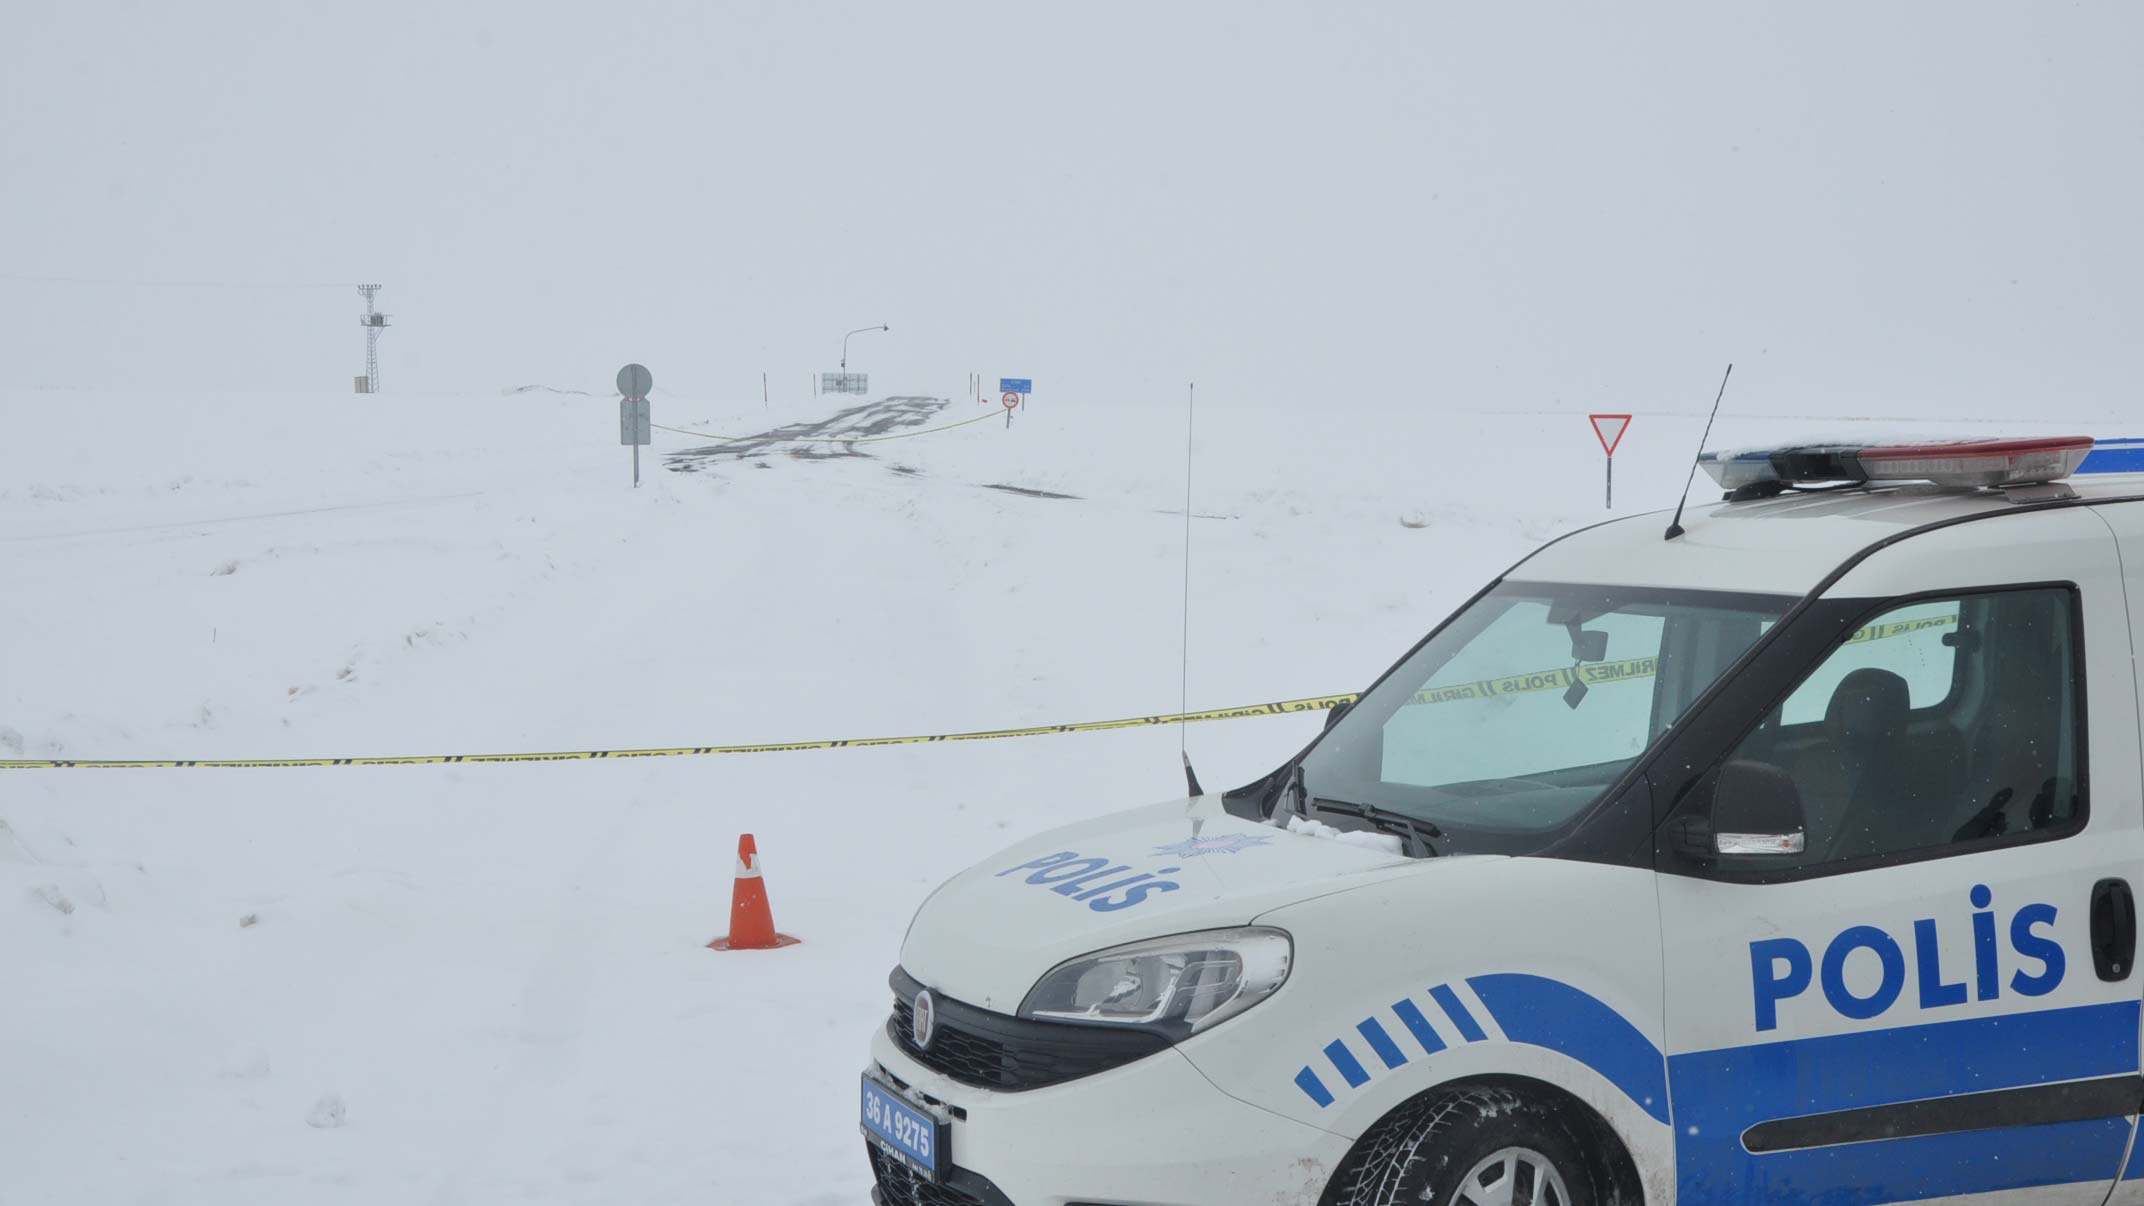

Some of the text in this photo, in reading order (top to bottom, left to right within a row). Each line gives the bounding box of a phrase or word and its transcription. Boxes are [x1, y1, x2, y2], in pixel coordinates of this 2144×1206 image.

[994, 851, 1180, 912] POLİS
[1749, 884, 2066, 1032] POLİS
[866, 1091, 930, 1157] 36 A 9275
